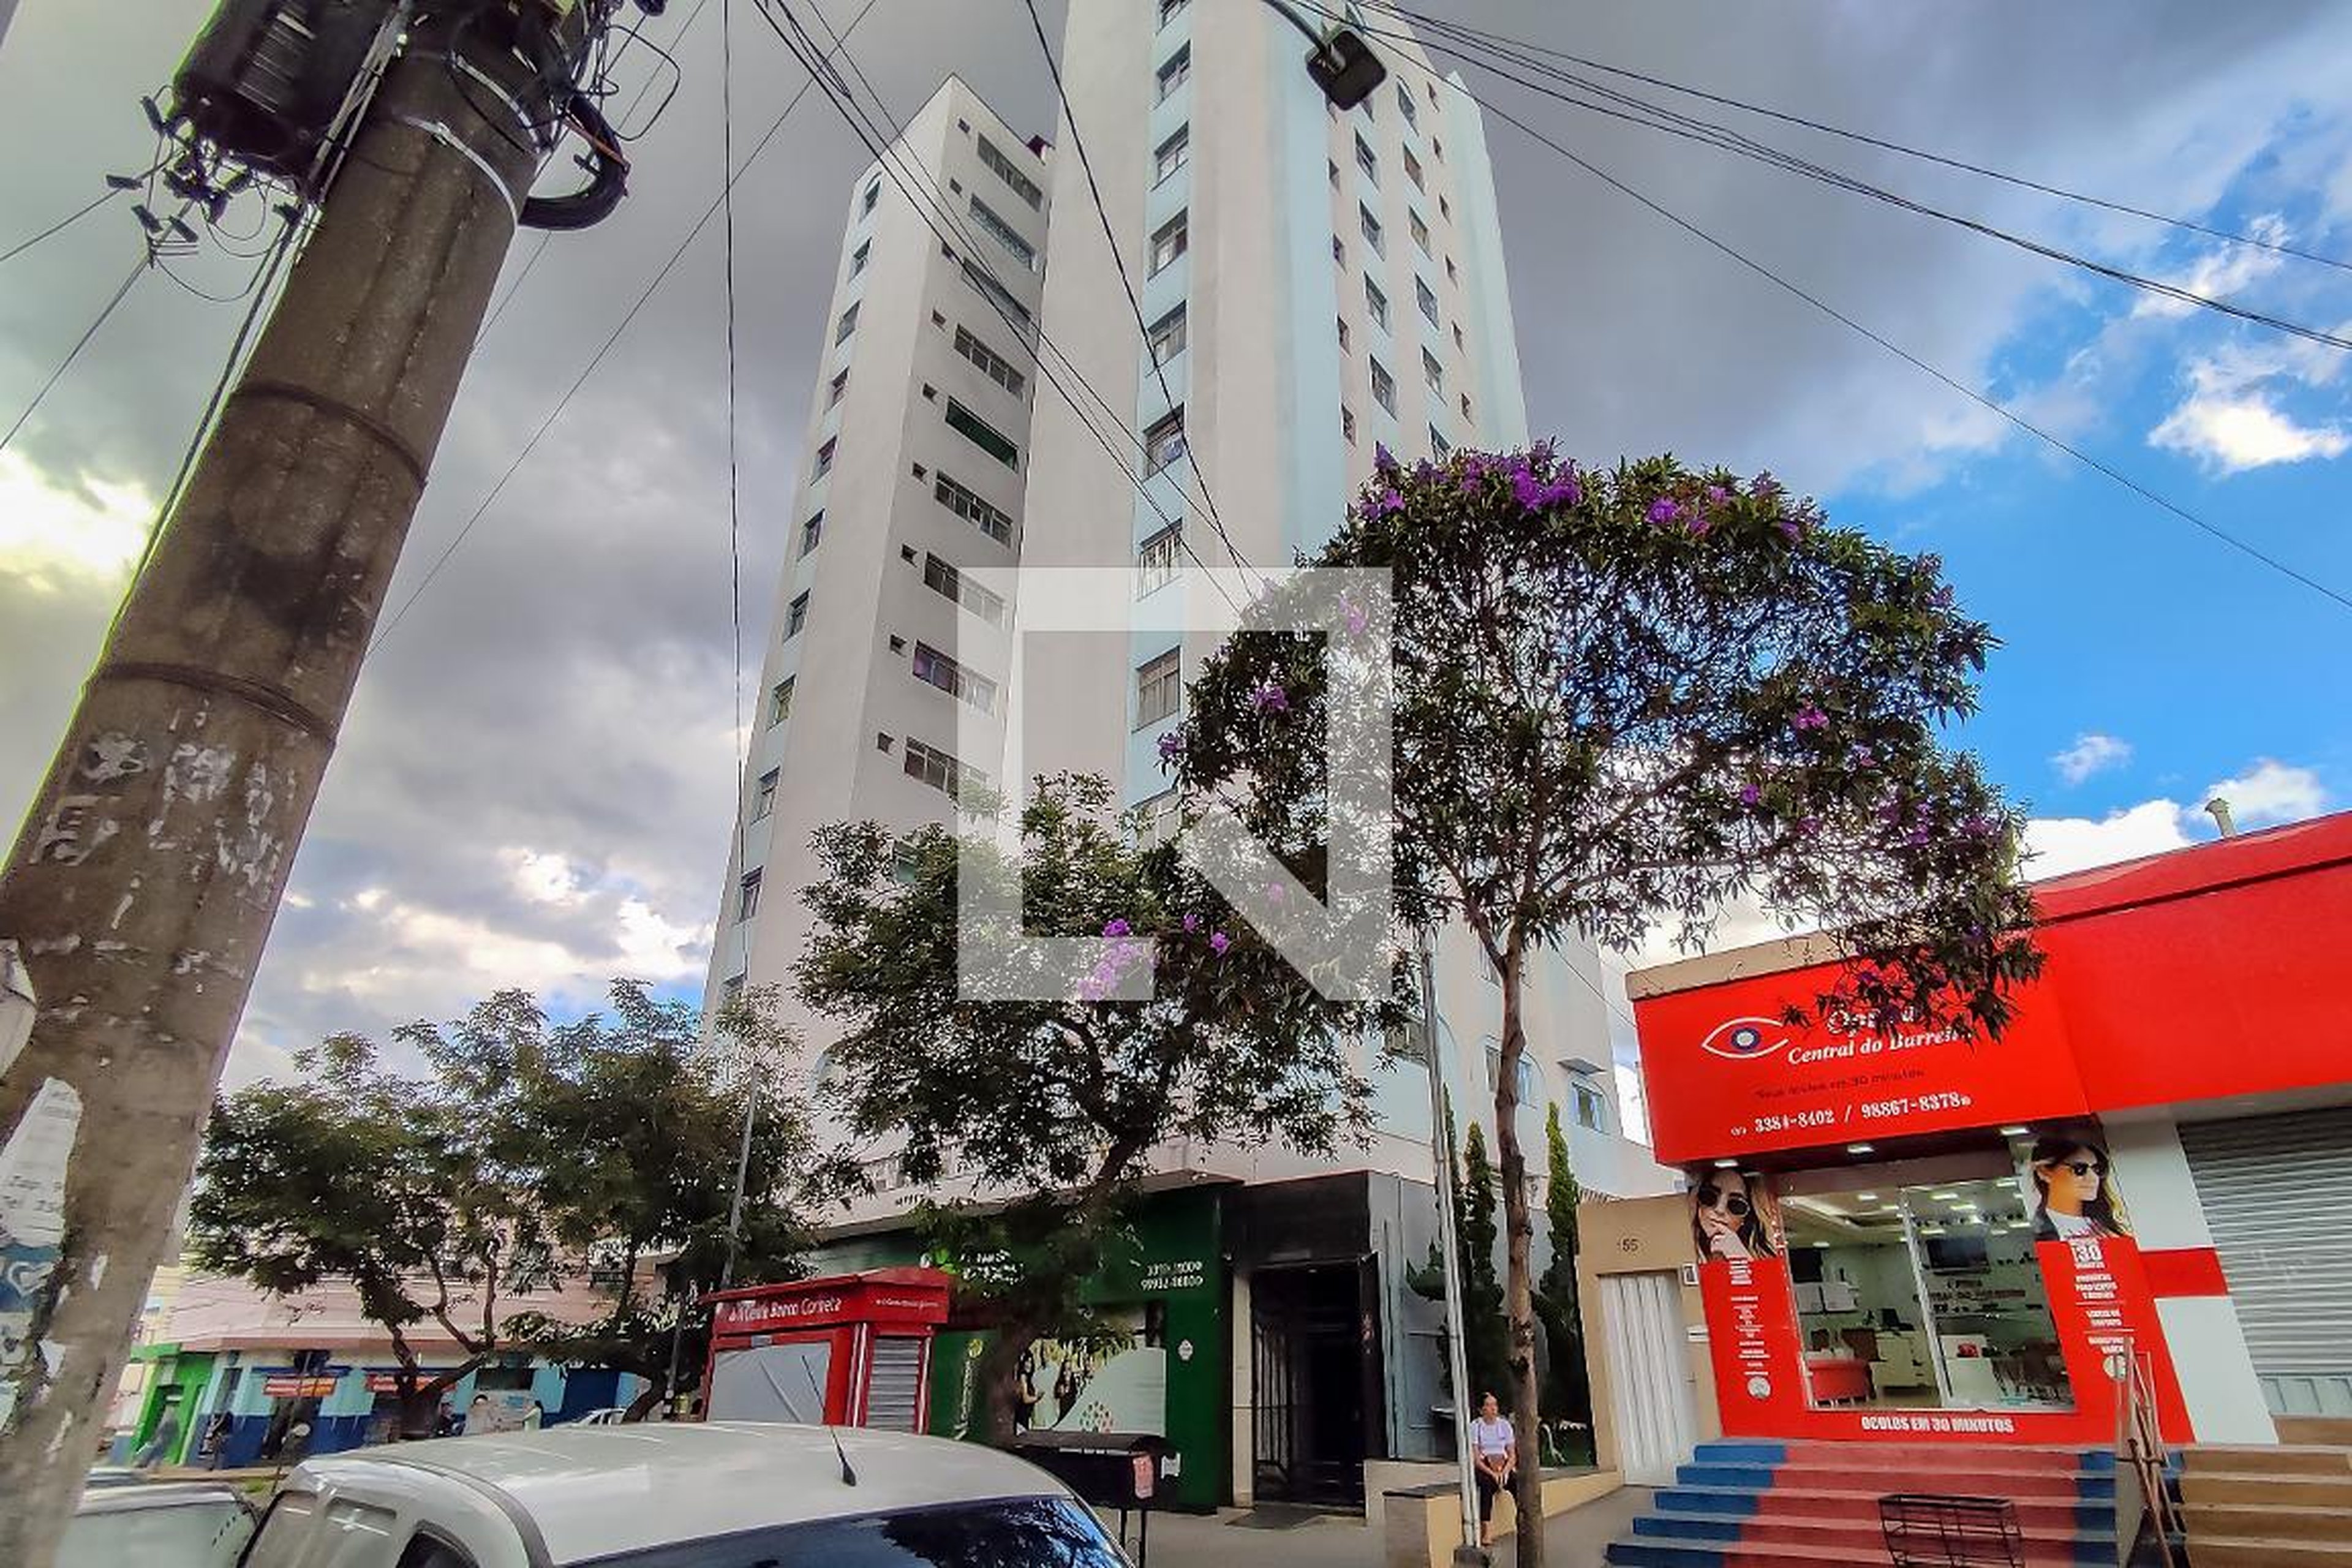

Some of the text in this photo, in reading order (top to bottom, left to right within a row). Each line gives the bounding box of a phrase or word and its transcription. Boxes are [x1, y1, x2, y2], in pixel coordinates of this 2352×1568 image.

[1788, 1039, 1855, 1066] Central
[1860, 1038, 1883, 1054] do
[1861, 1091, 1961, 1120] 98867-8378
[1910, 1417, 1930, 1431] EM
[1931, 1418, 1950, 1432] 30
[1951, 1418, 2015, 1433] MINUTOS
